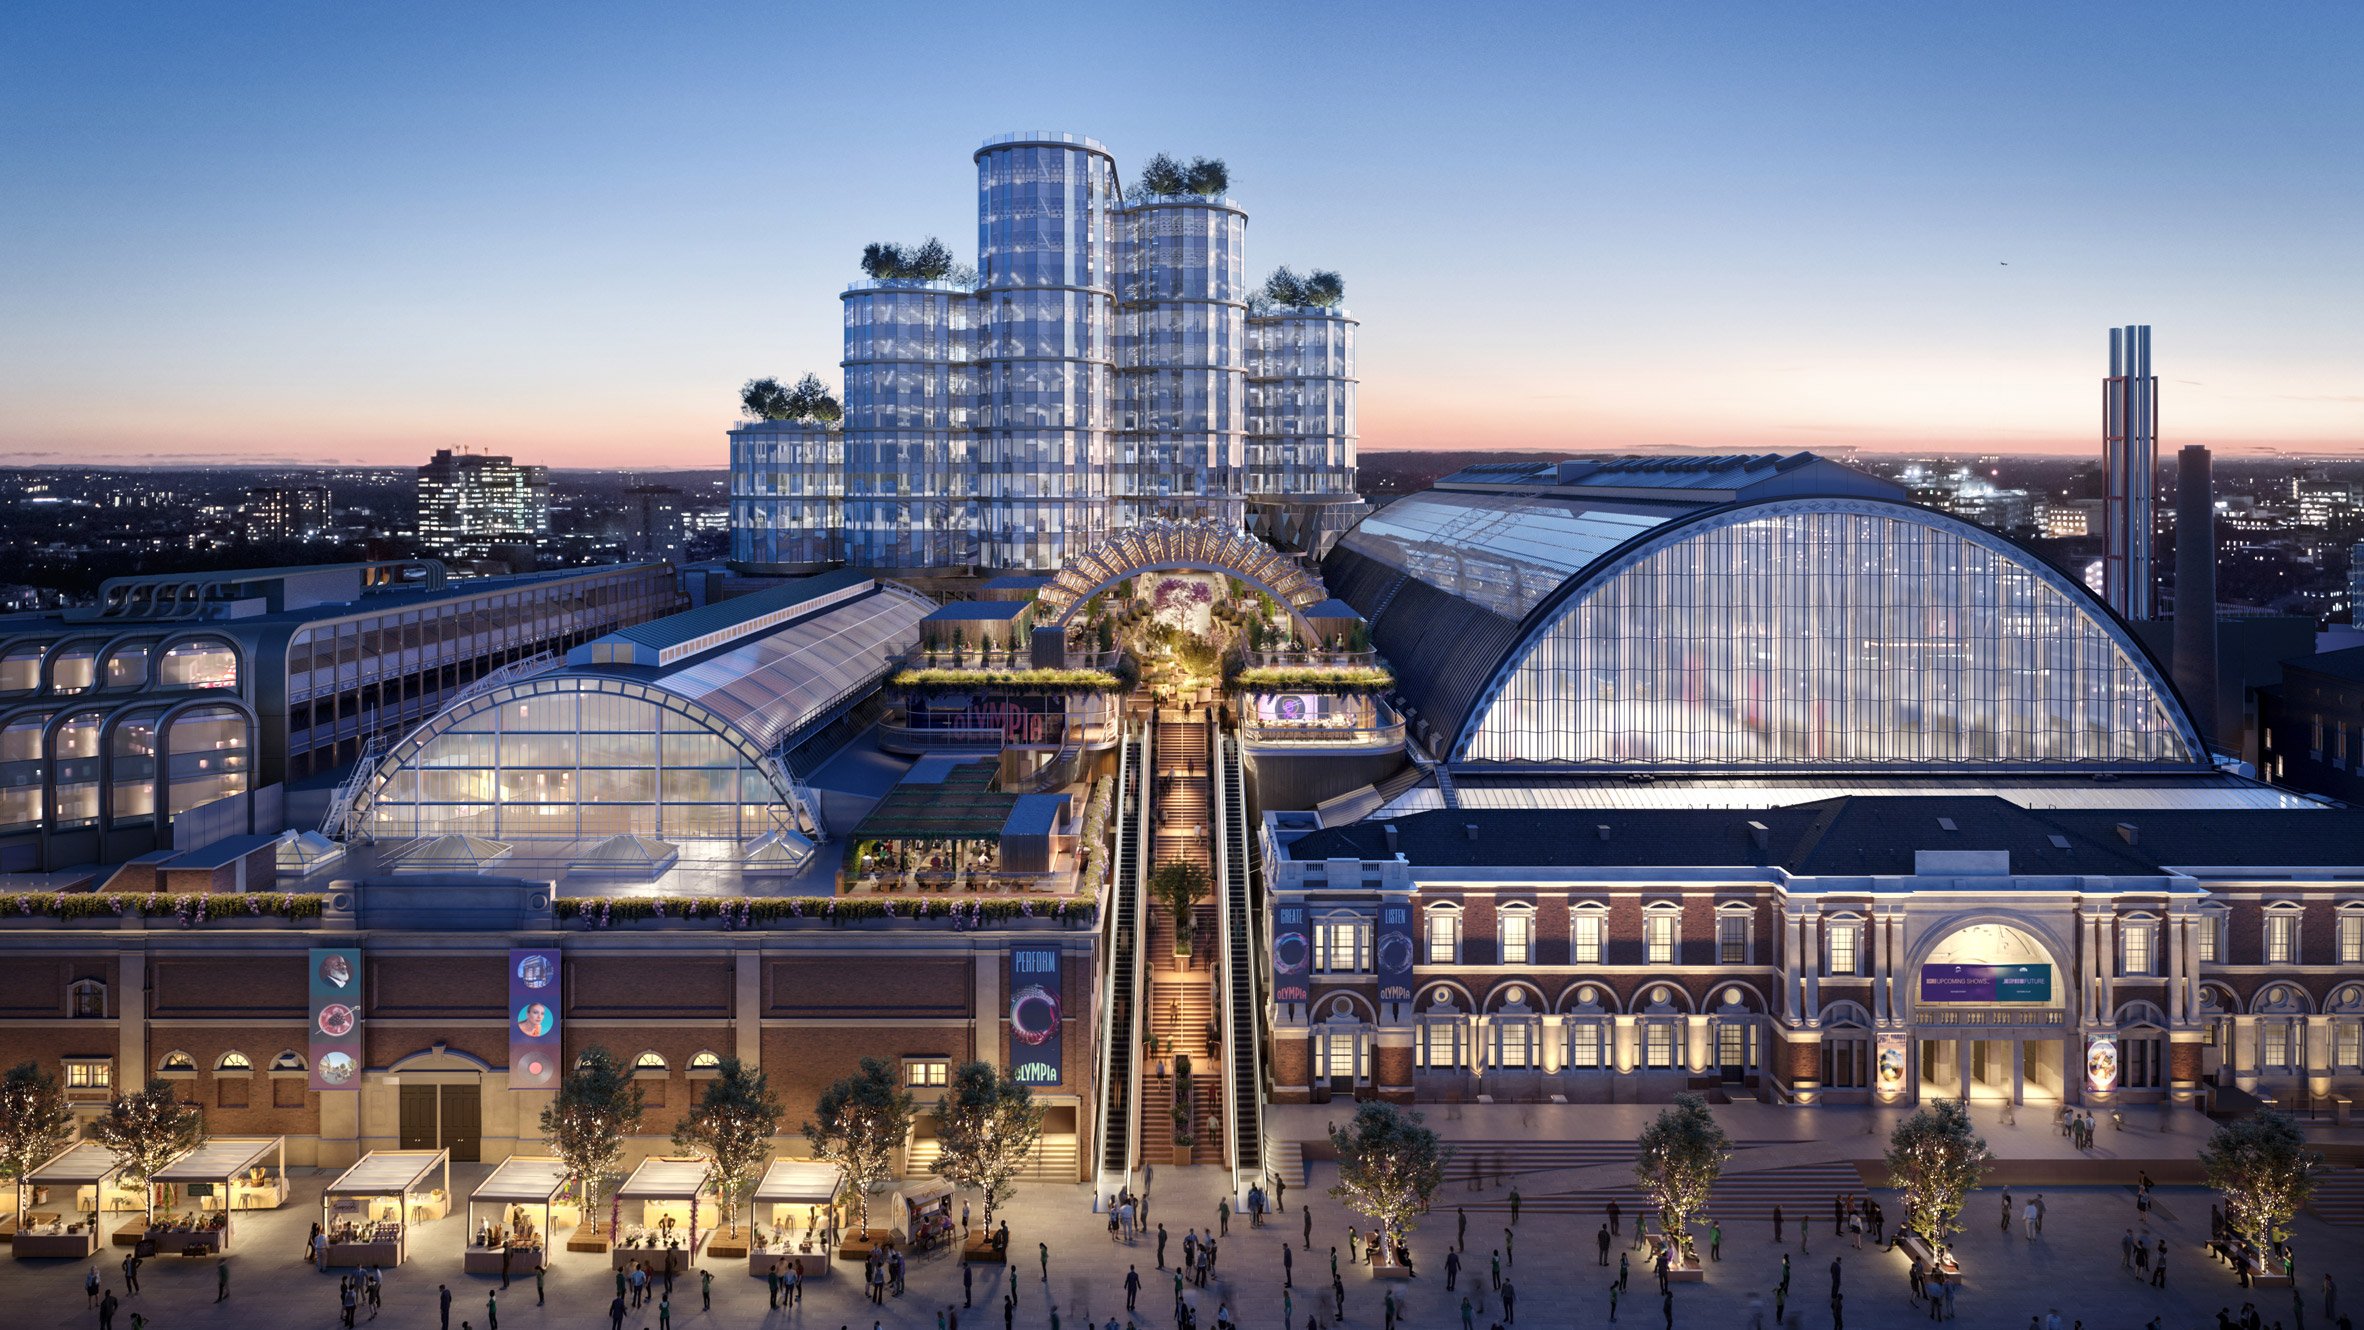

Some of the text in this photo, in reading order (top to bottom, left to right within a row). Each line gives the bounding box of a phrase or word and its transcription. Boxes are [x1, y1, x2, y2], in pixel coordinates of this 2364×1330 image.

[953, 702, 1042, 741] OLYMPIA
[1280, 909, 1303, 924] CREATE
[1385, 909, 1405, 924] LISTEN
[1016, 951, 1055, 973] PERFORM
[1277, 987, 1307, 1000] OLYMPIA
[1380, 986, 1411, 1000] OLYMPIA
[1014, 1062, 1057, 1082] OLYMPIA
